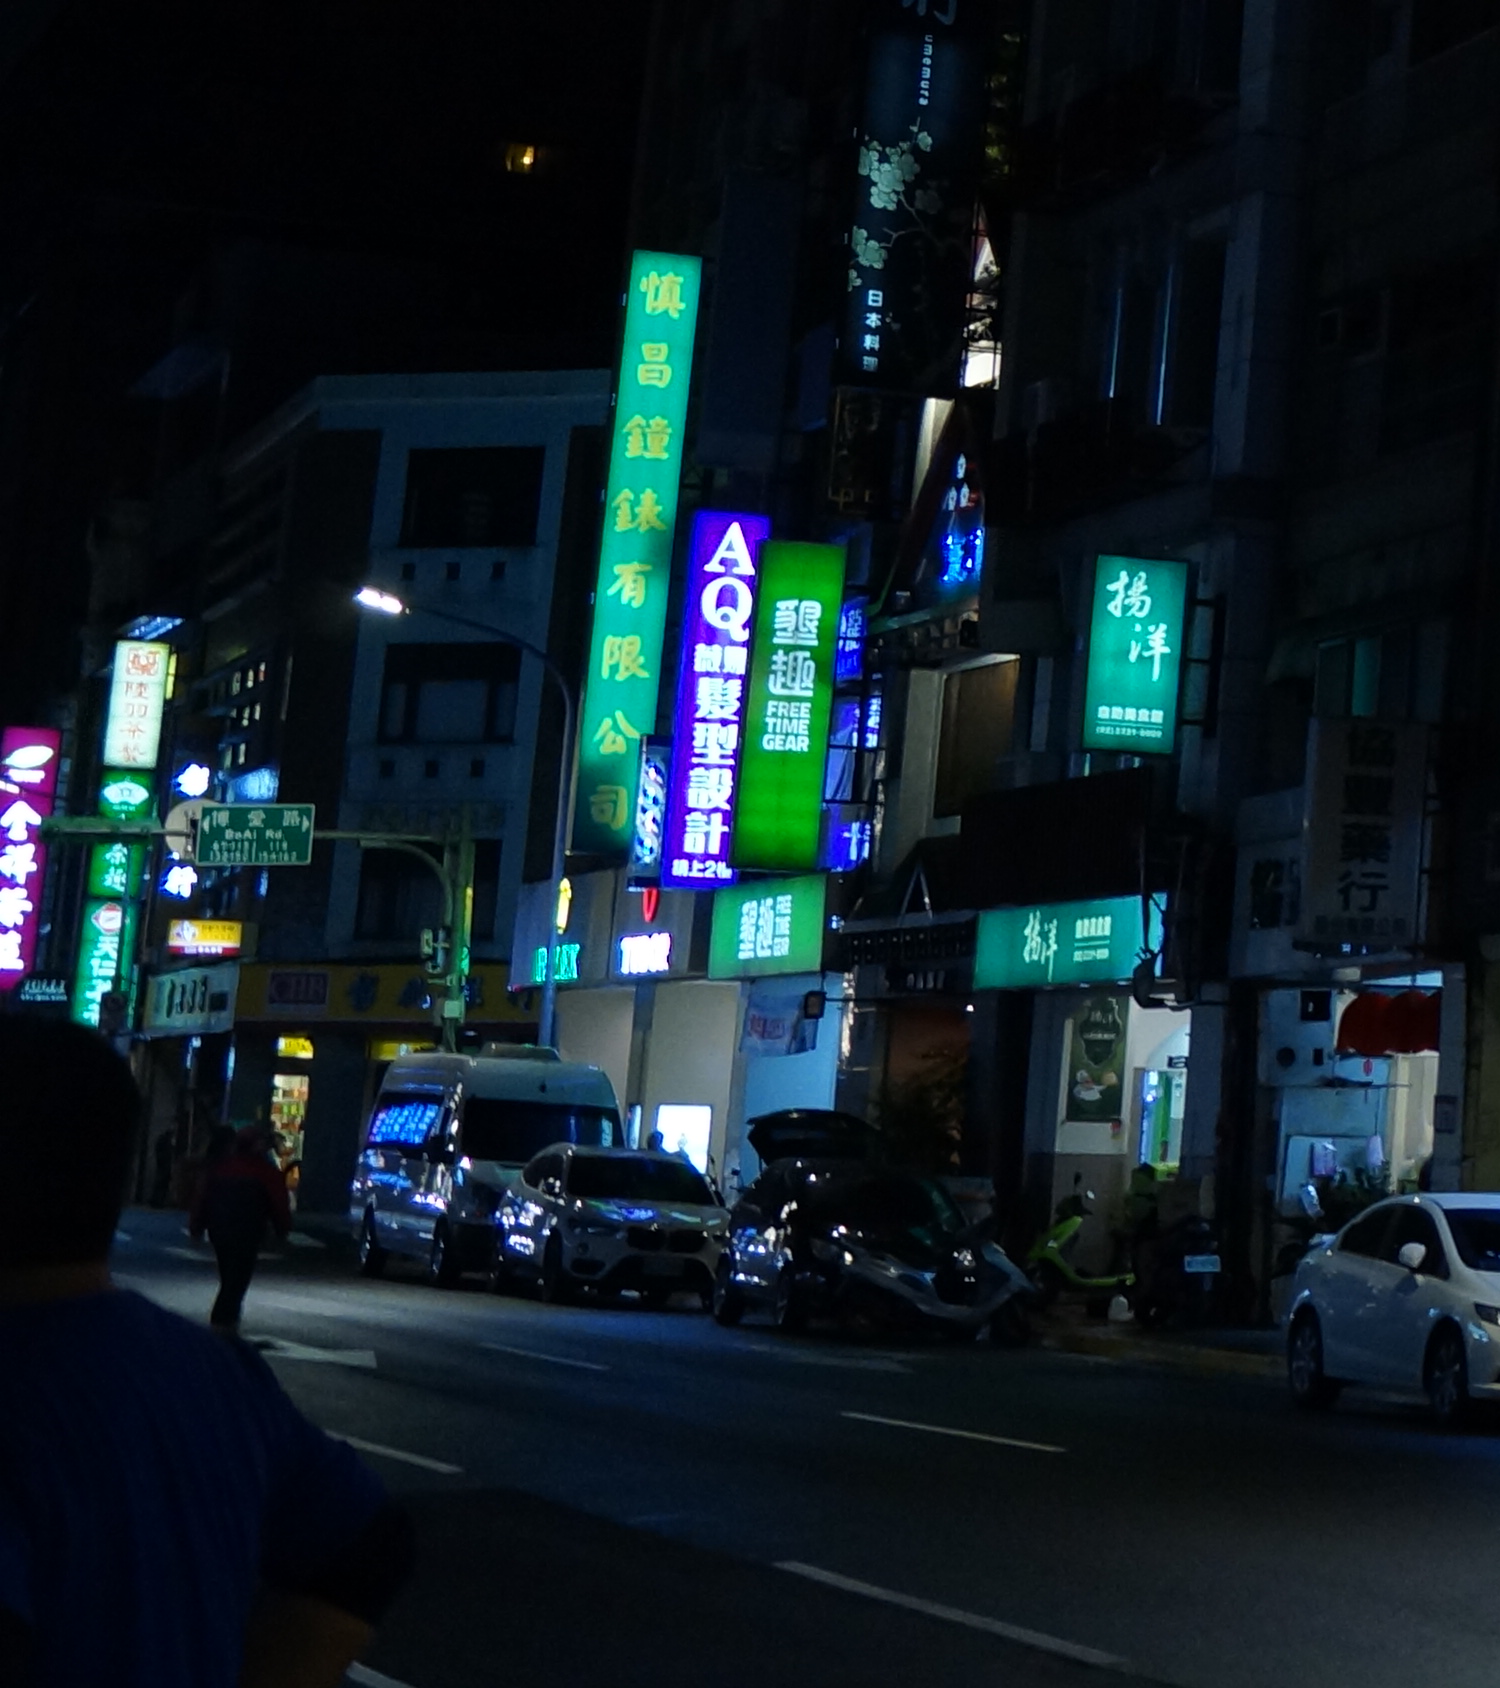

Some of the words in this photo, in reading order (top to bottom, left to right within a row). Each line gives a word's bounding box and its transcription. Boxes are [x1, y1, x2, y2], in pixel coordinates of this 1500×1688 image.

[1106, 570, 1171, 682] 揚洋
[766, 700, 812, 719] FREE
[765, 717, 810, 735] TIME
[762, 734, 809, 752] GEAR
